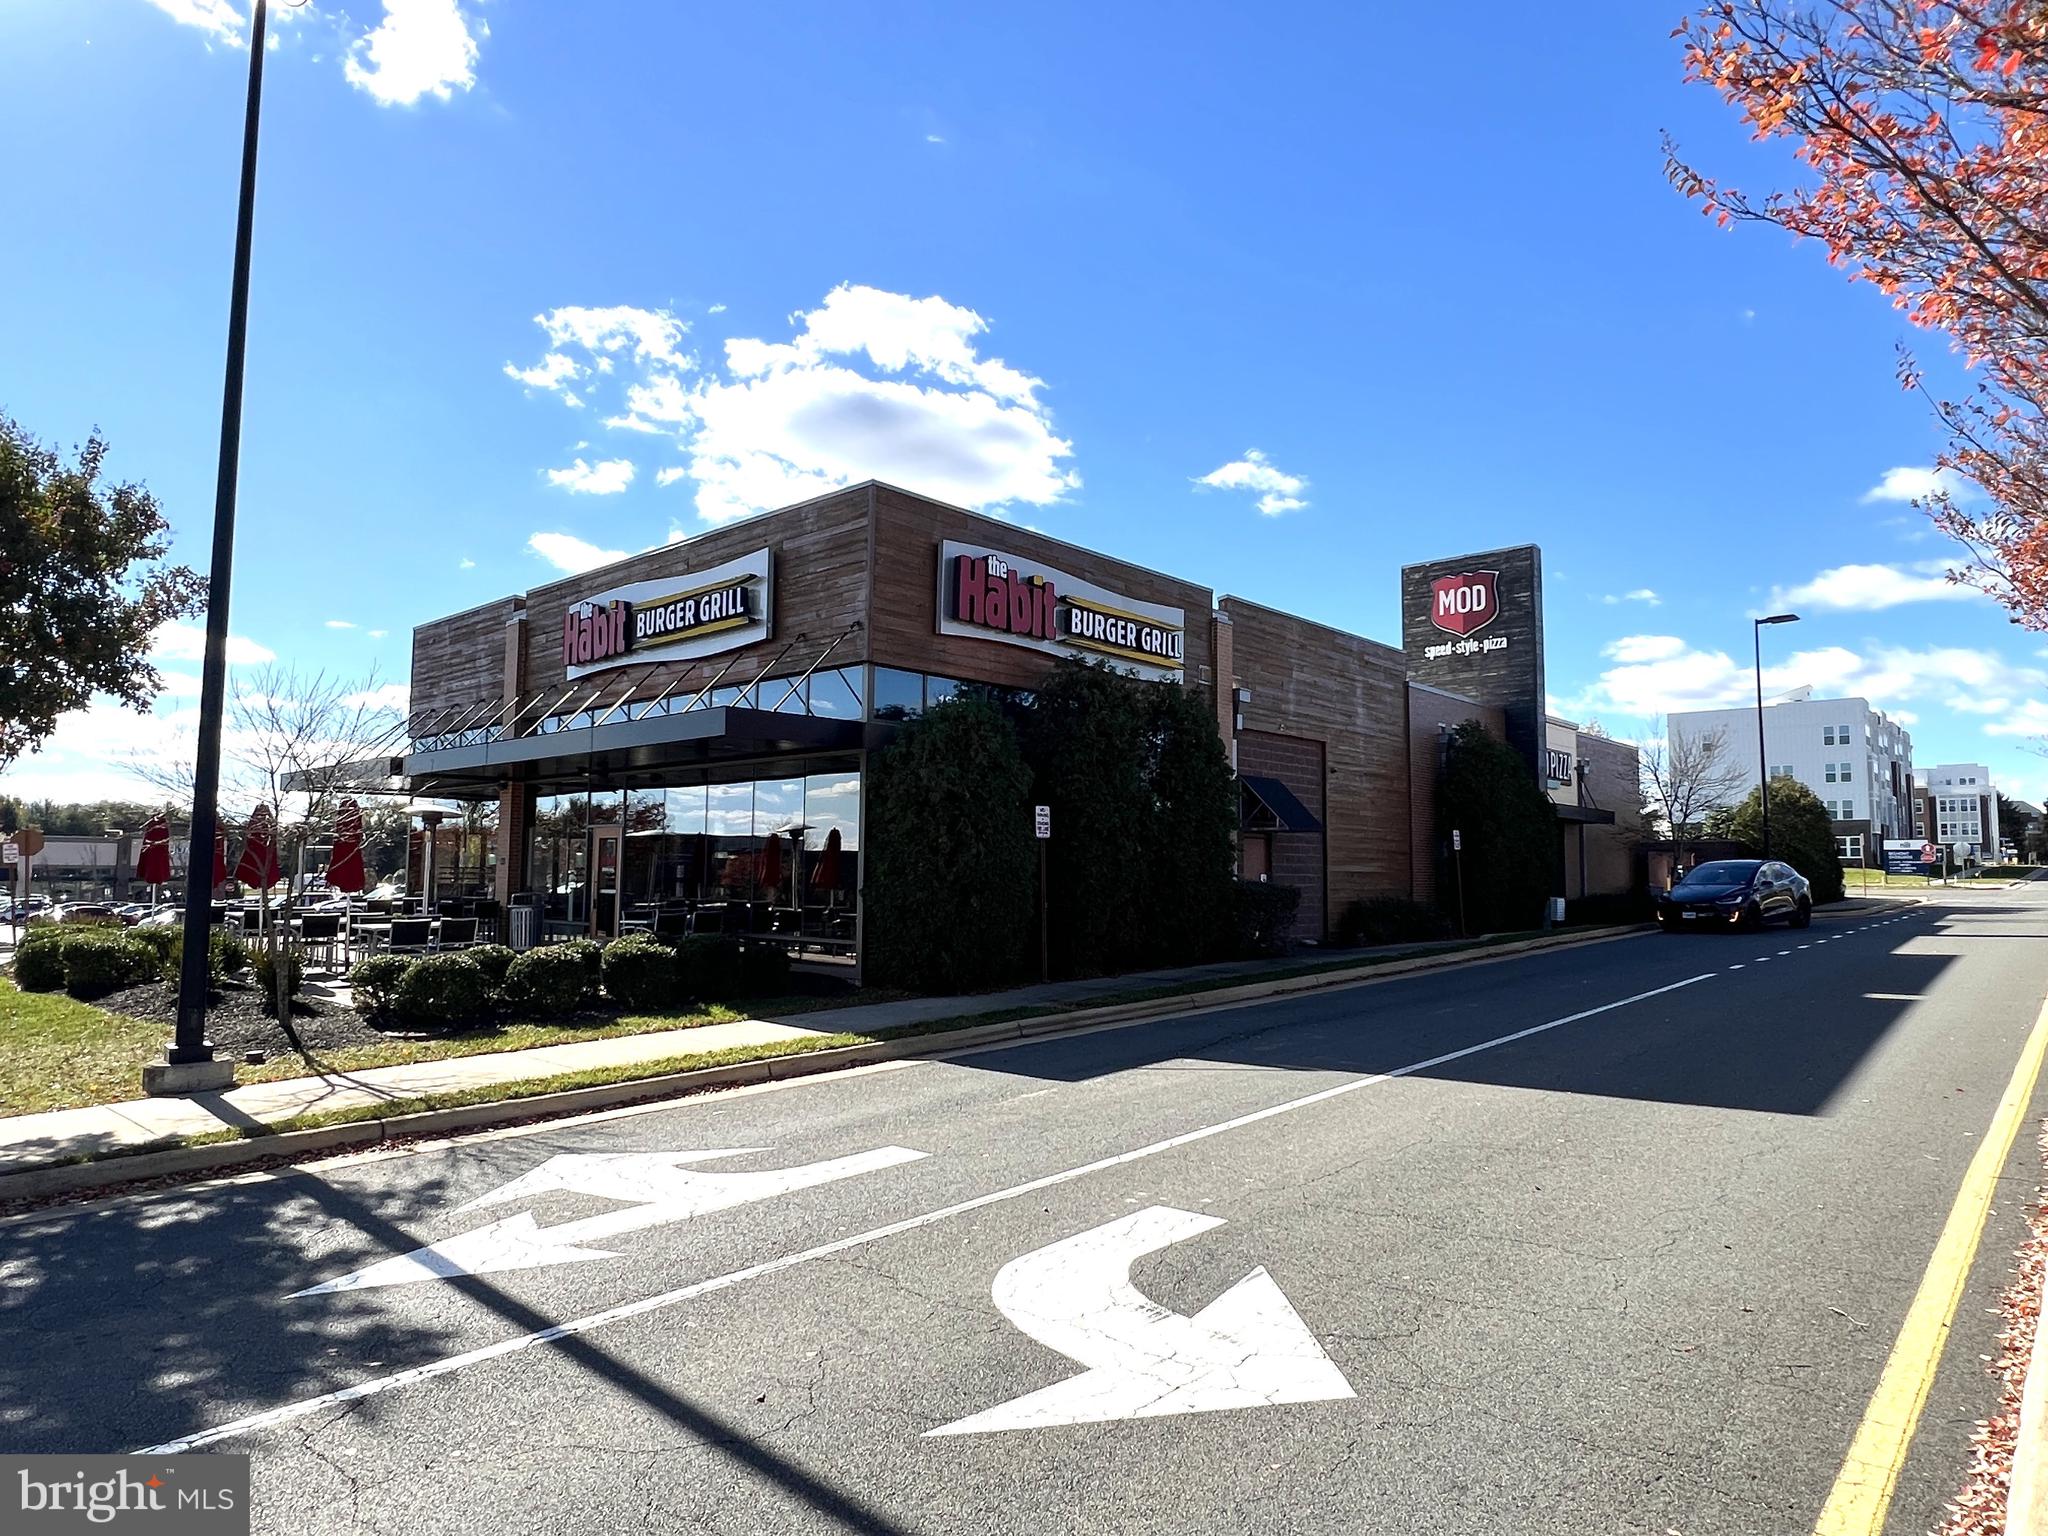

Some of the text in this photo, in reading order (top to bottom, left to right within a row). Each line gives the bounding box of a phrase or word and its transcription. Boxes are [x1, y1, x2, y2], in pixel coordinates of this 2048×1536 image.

[987, 555, 1008, 579] the
[563, 587, 744, 665] Habit BURGER GRILL
[958, 555, 1182, 658] Habit BURGER GRILL
[1438, 584, 1487, 616] MOD
